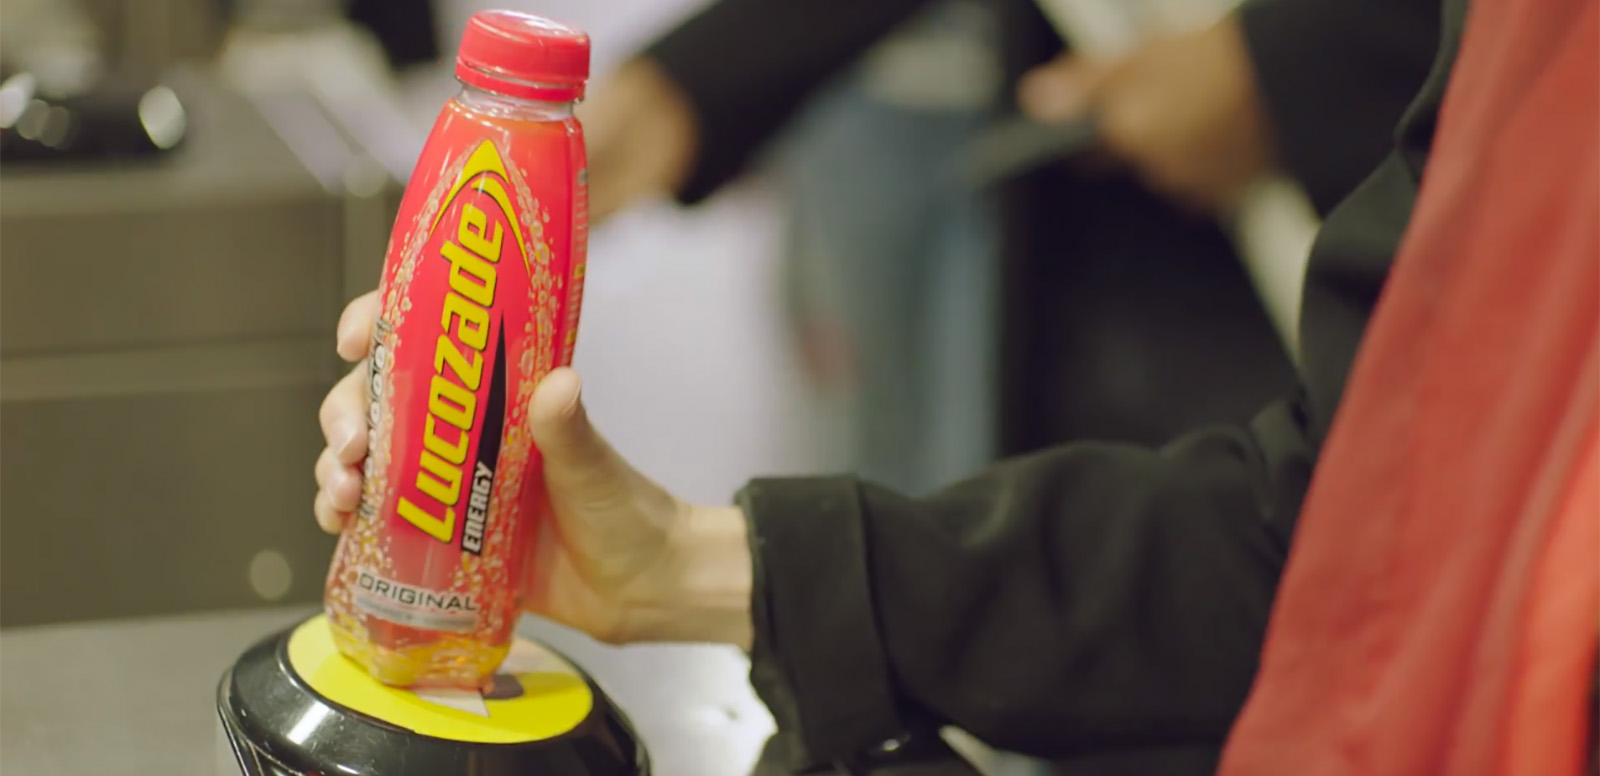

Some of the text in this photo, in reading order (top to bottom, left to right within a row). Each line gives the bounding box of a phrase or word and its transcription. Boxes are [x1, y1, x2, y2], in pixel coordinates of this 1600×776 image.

[397, 203, 504, 544] Lucozade
[462, 460, 493, 553] ENERGY
[358, 571, 477, 612] ORIGINAL
